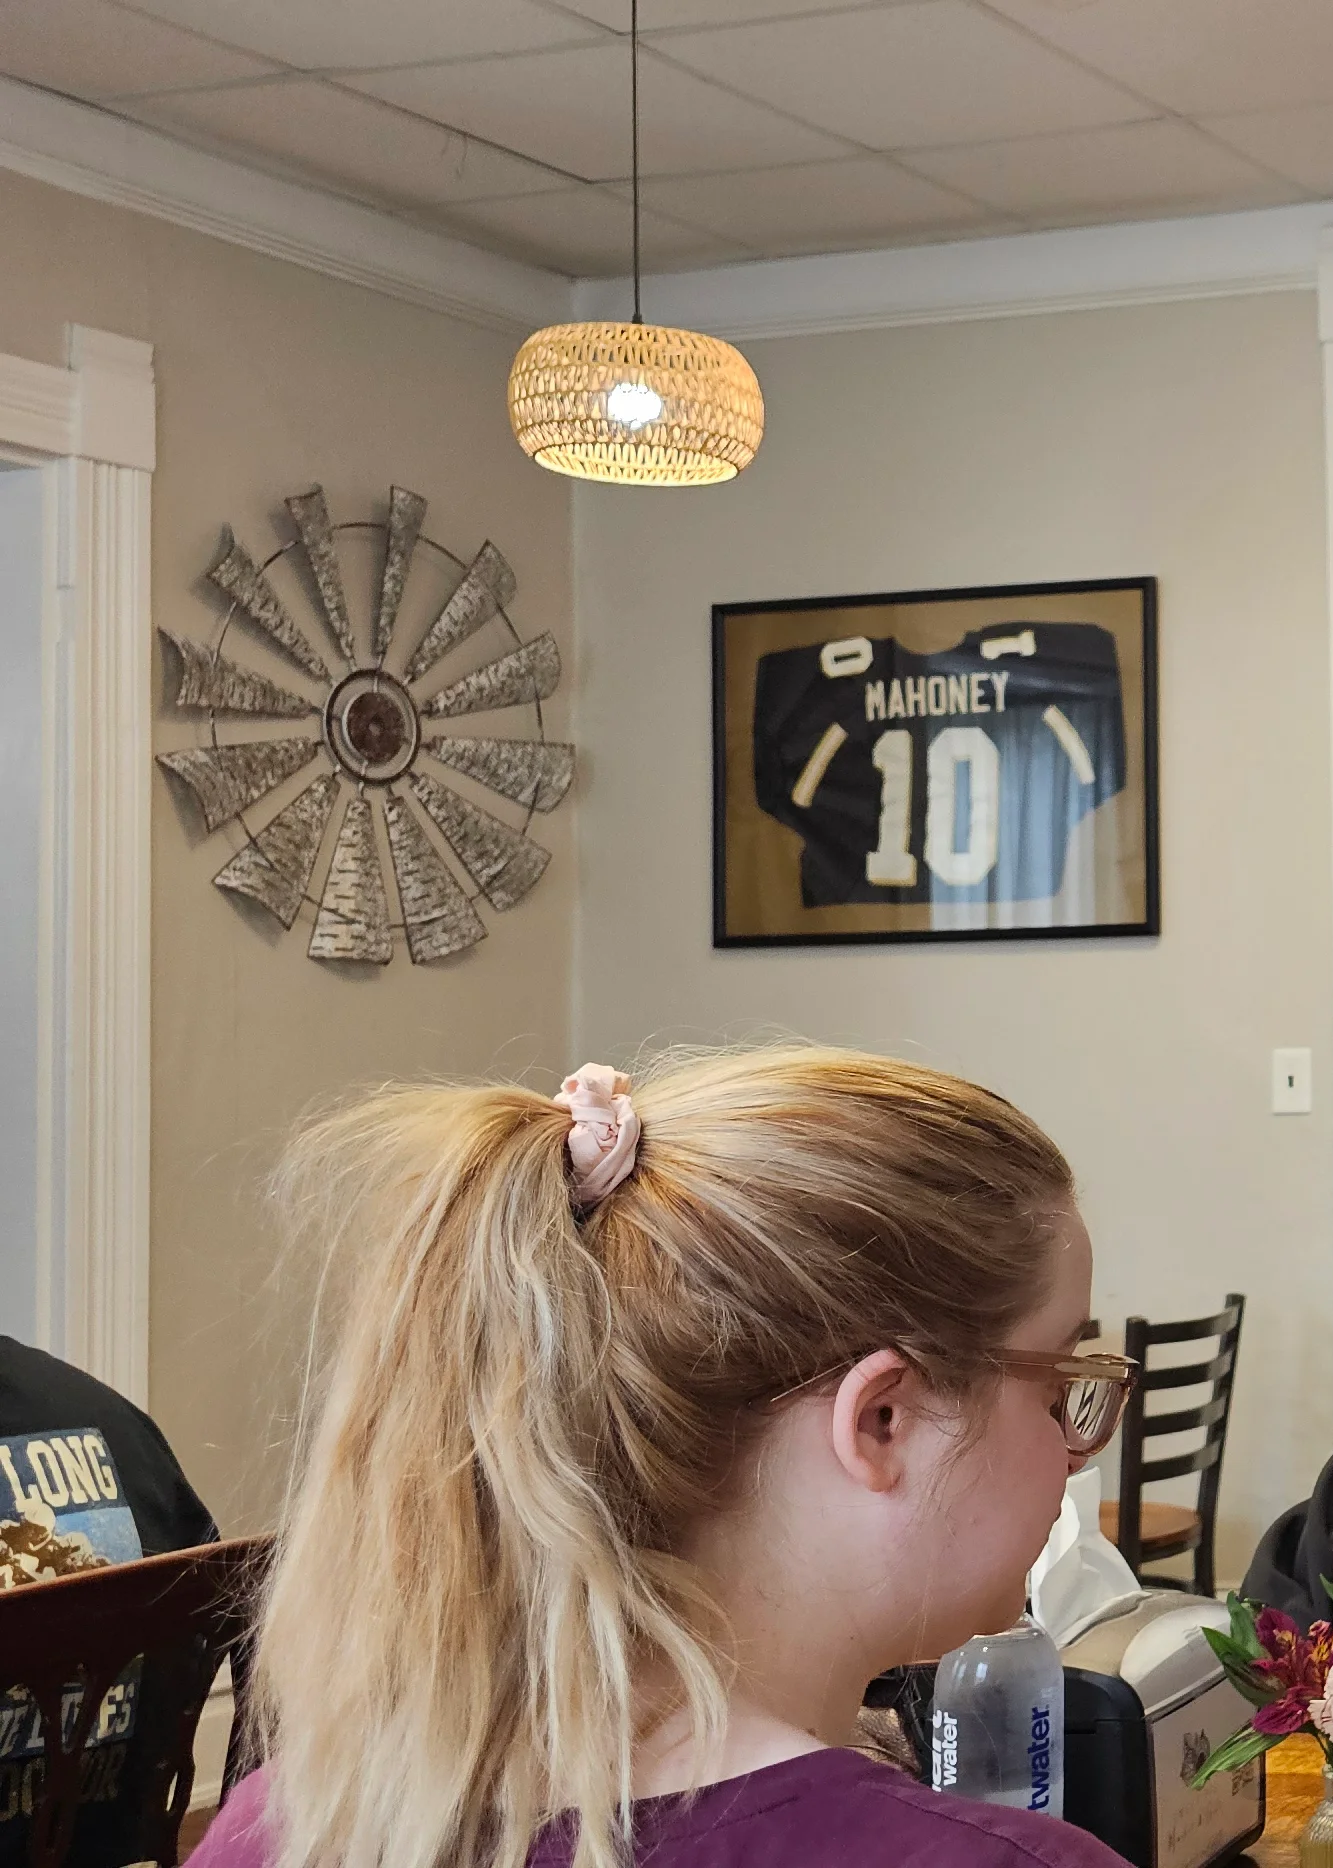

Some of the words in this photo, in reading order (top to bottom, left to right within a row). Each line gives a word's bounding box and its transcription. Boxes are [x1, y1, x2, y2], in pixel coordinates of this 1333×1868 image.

[864, 671, 1010, 721] MAHONEY
[866, 726, 1000, 887] 10
[0, 1434, 118, 1513] LONG
[931, 1709, 942, 1792] art
[942, 1712, 958, 1786] water
[1027, 1704, 1050, 1811] twater
